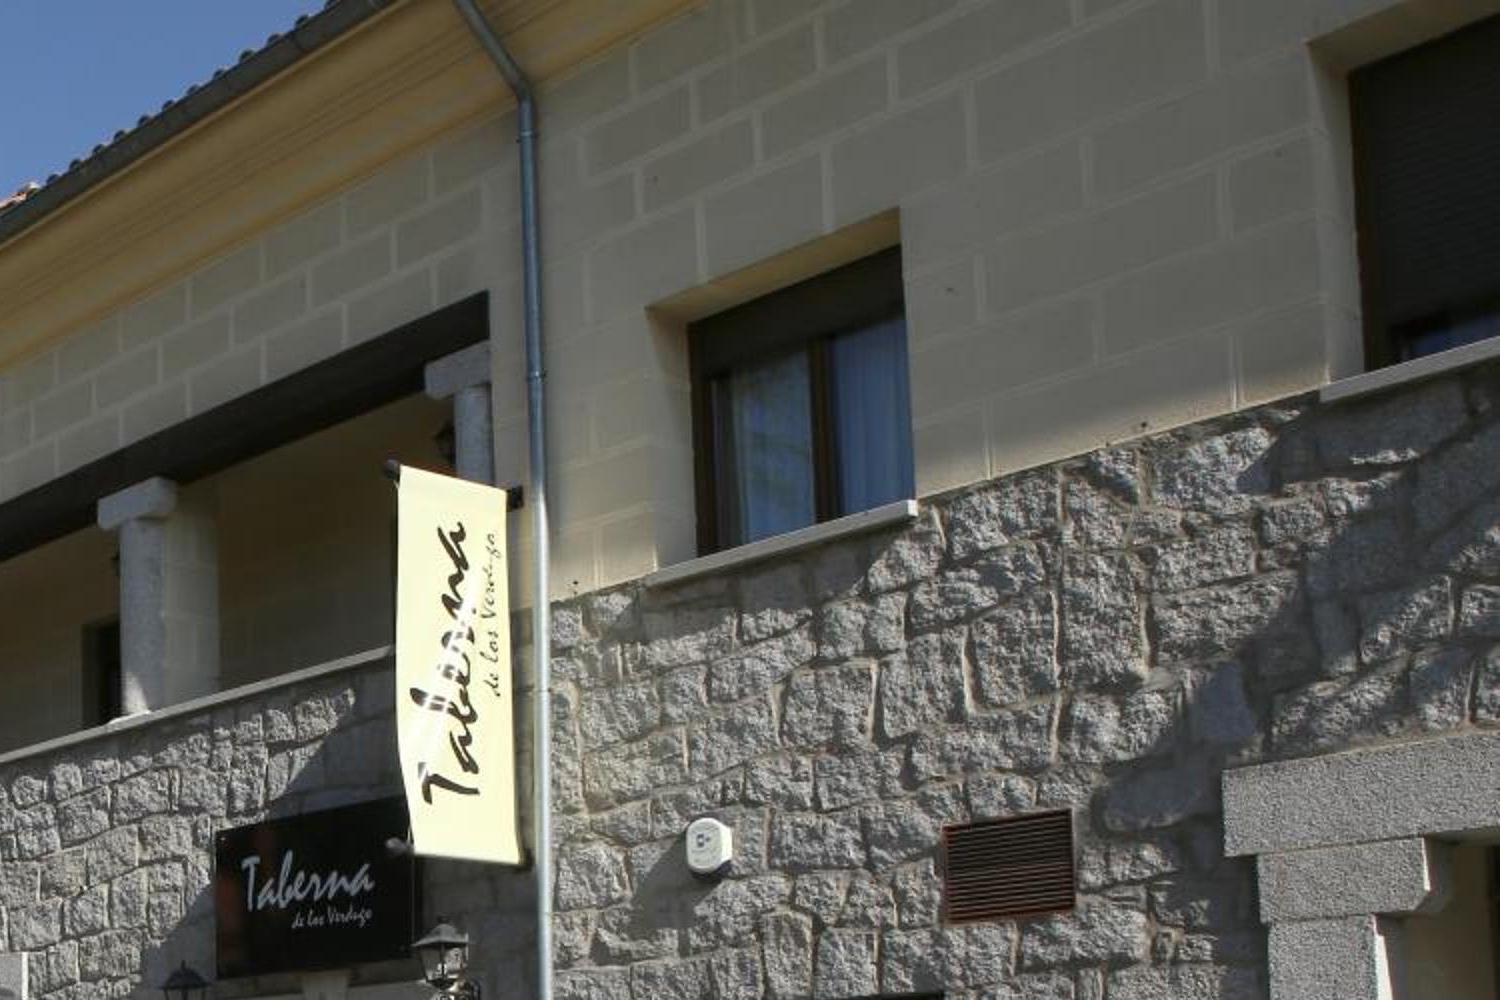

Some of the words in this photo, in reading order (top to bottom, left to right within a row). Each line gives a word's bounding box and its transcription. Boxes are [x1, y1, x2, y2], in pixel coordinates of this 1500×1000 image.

[409, 520, 480, 805] Taberna
[483, 673, 501, 697] de
[241, 849, 376, 912] Taberna
[291, 911, 304, 929] de
